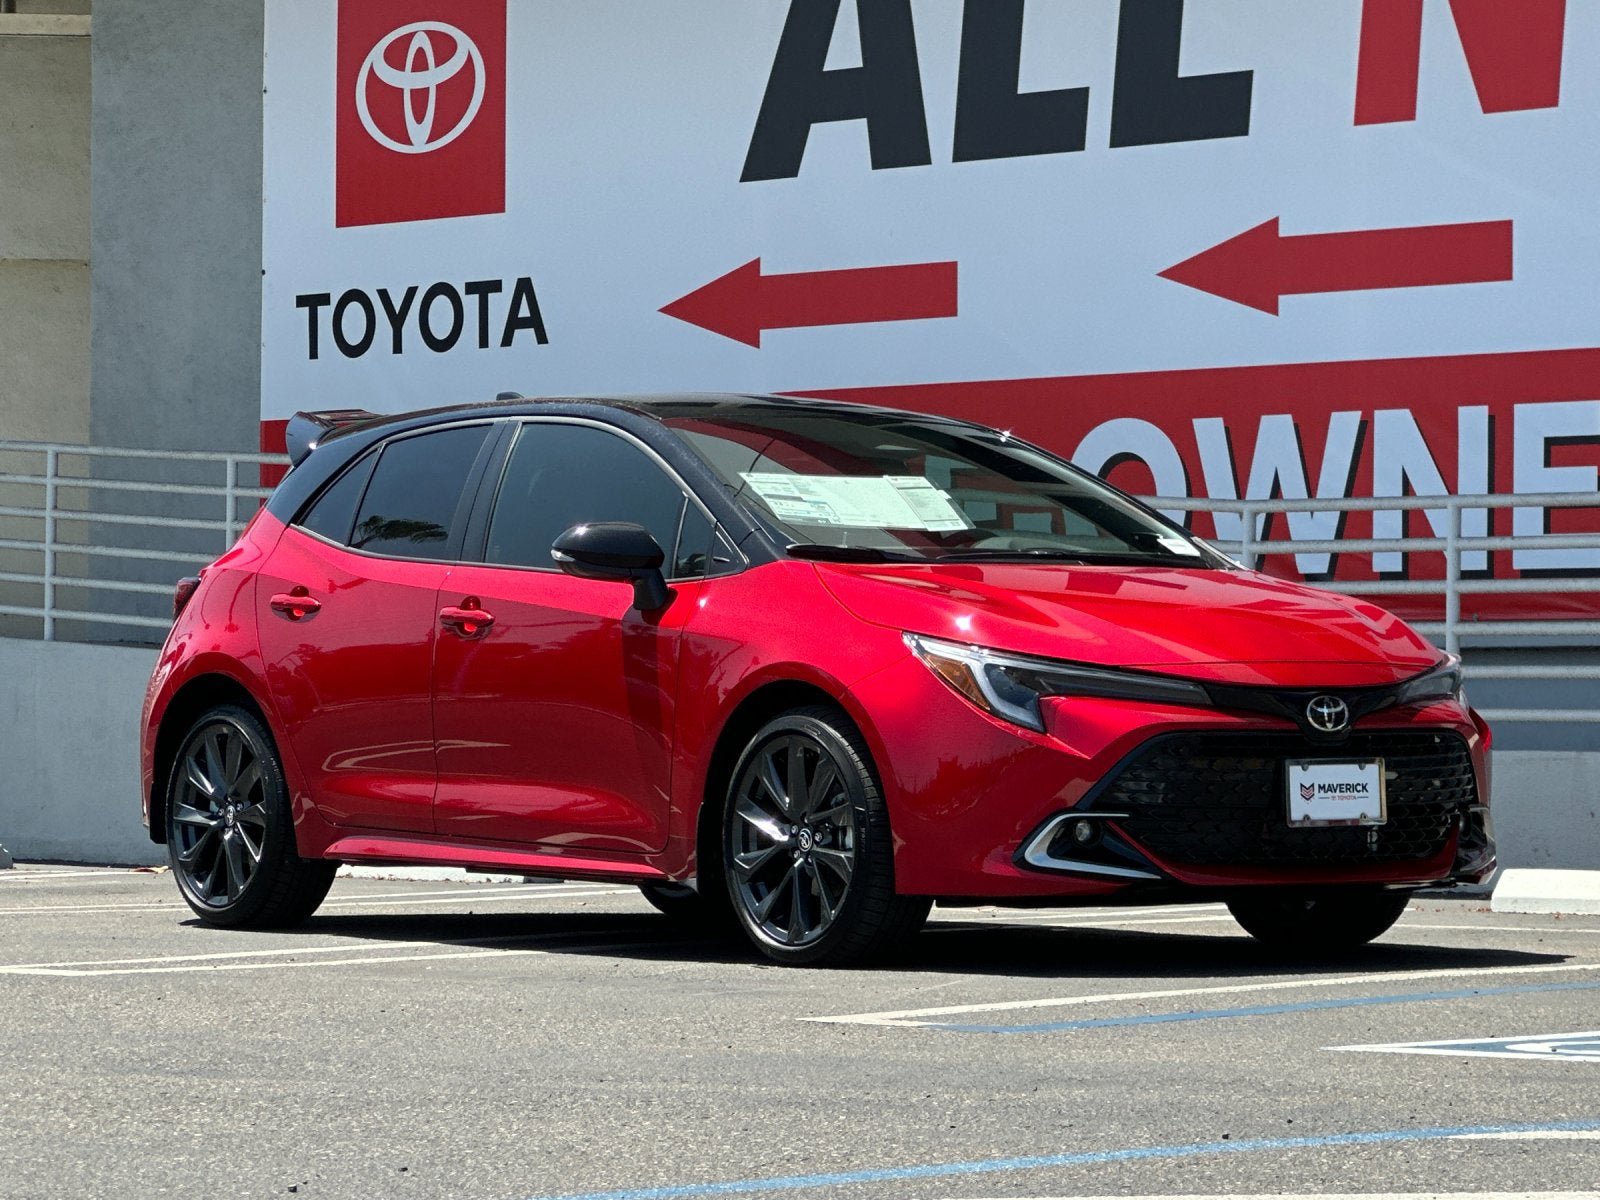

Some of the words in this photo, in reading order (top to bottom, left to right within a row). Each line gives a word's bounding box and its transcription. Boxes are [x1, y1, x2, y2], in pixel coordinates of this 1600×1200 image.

[740, 0, 1253, 182] ALL
[296, 277, 549, 360] TOYOTA
[1317, 783, 1369, 794] MAVERICK
